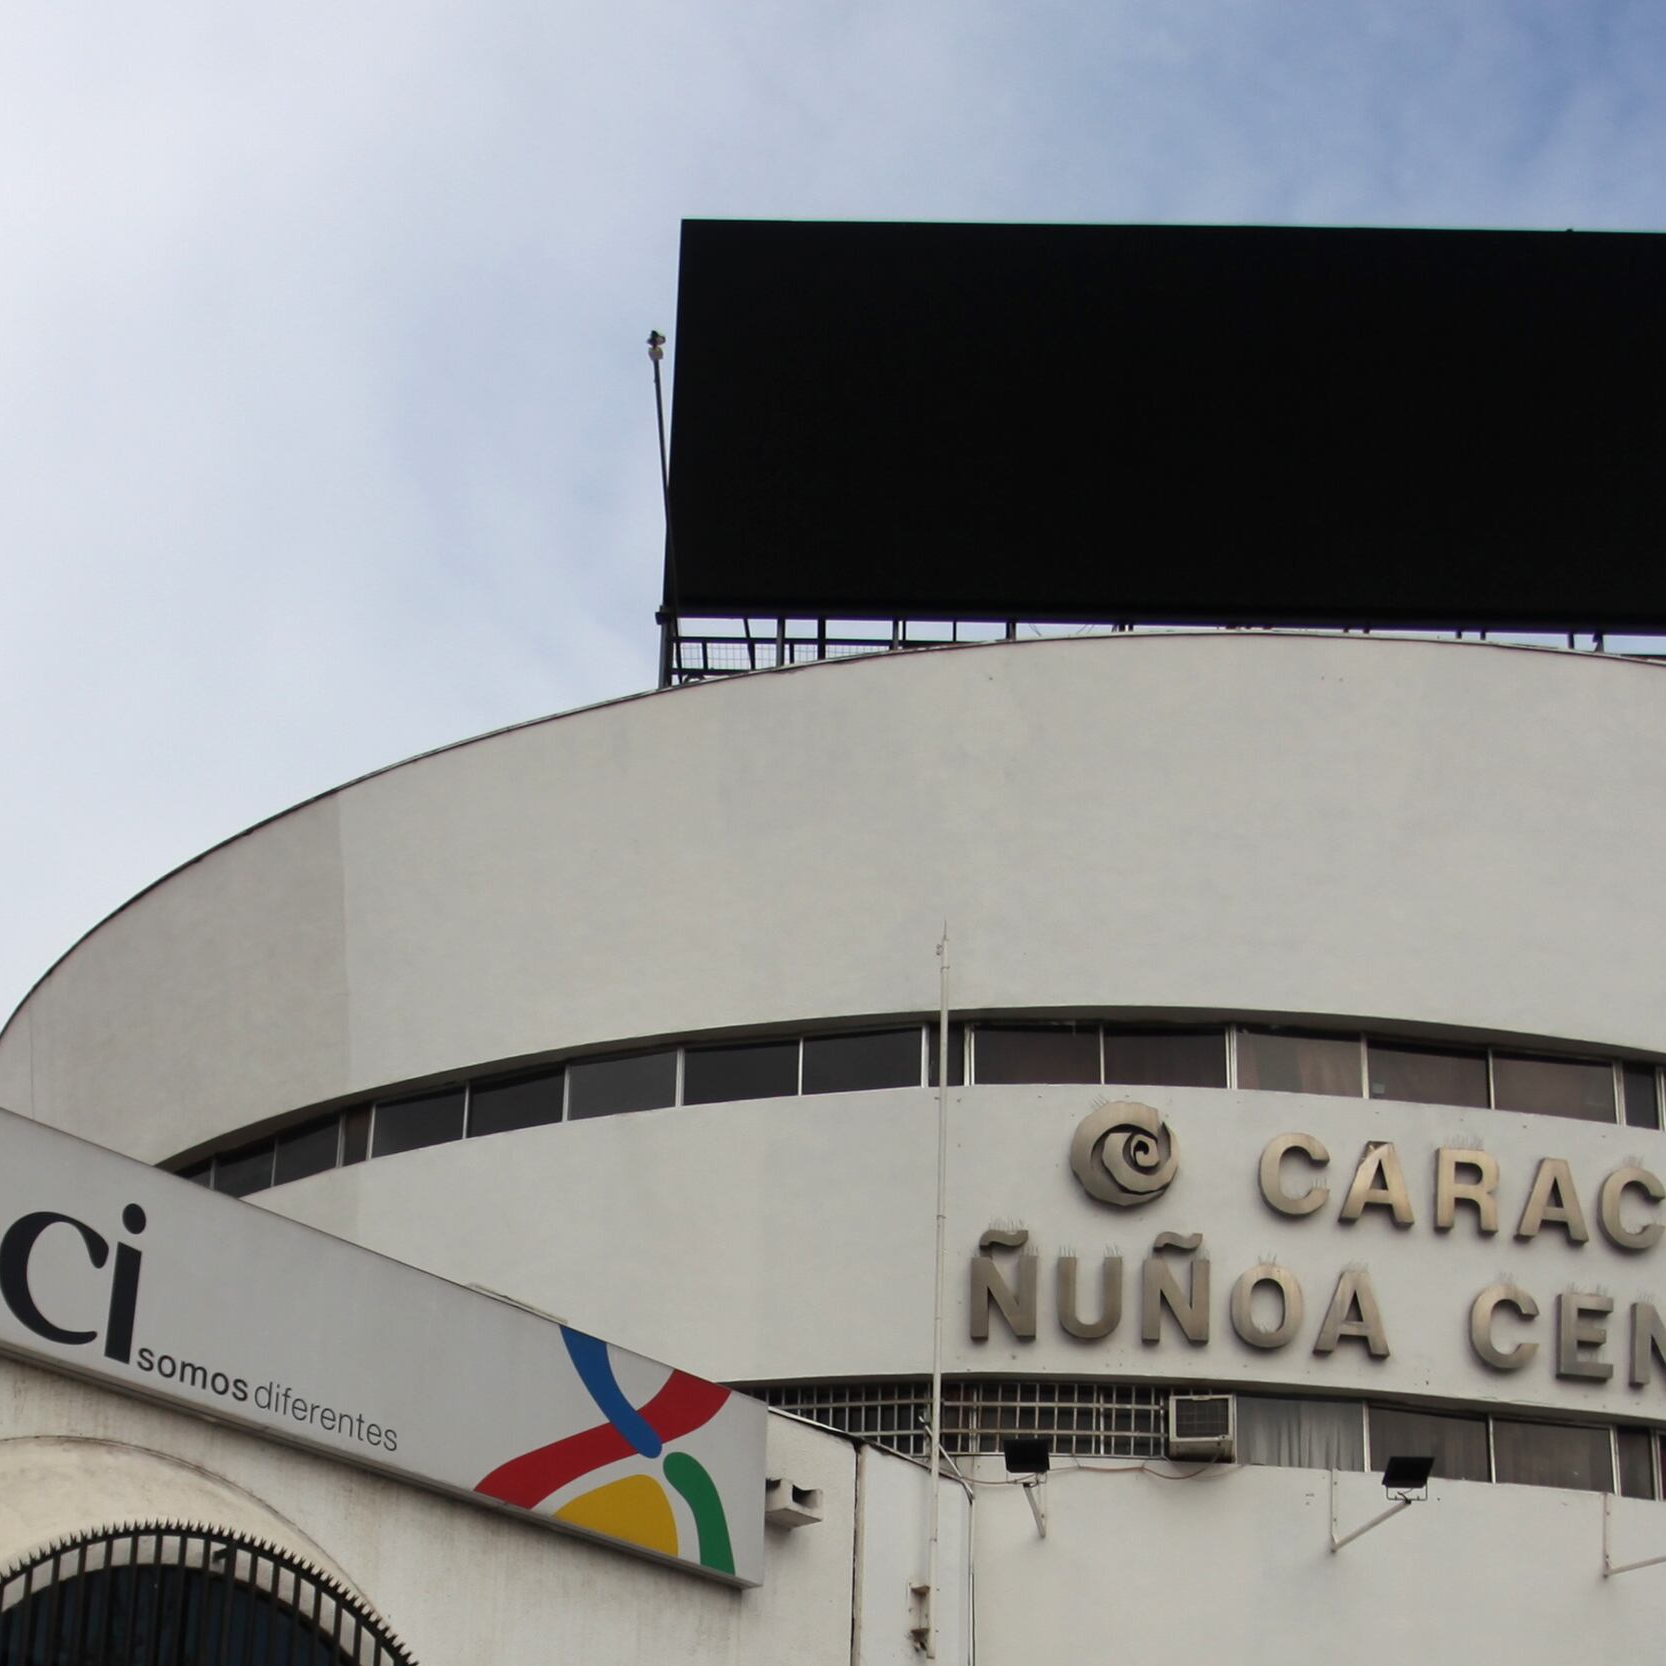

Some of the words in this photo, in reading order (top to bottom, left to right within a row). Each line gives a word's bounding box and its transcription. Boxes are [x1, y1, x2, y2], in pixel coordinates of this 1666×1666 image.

[970, 1229, 1391, 1359] ÑUÑOA
[137, 1346, 249, 1402] somos
[253, 1381, 398, 1452] diferentes
